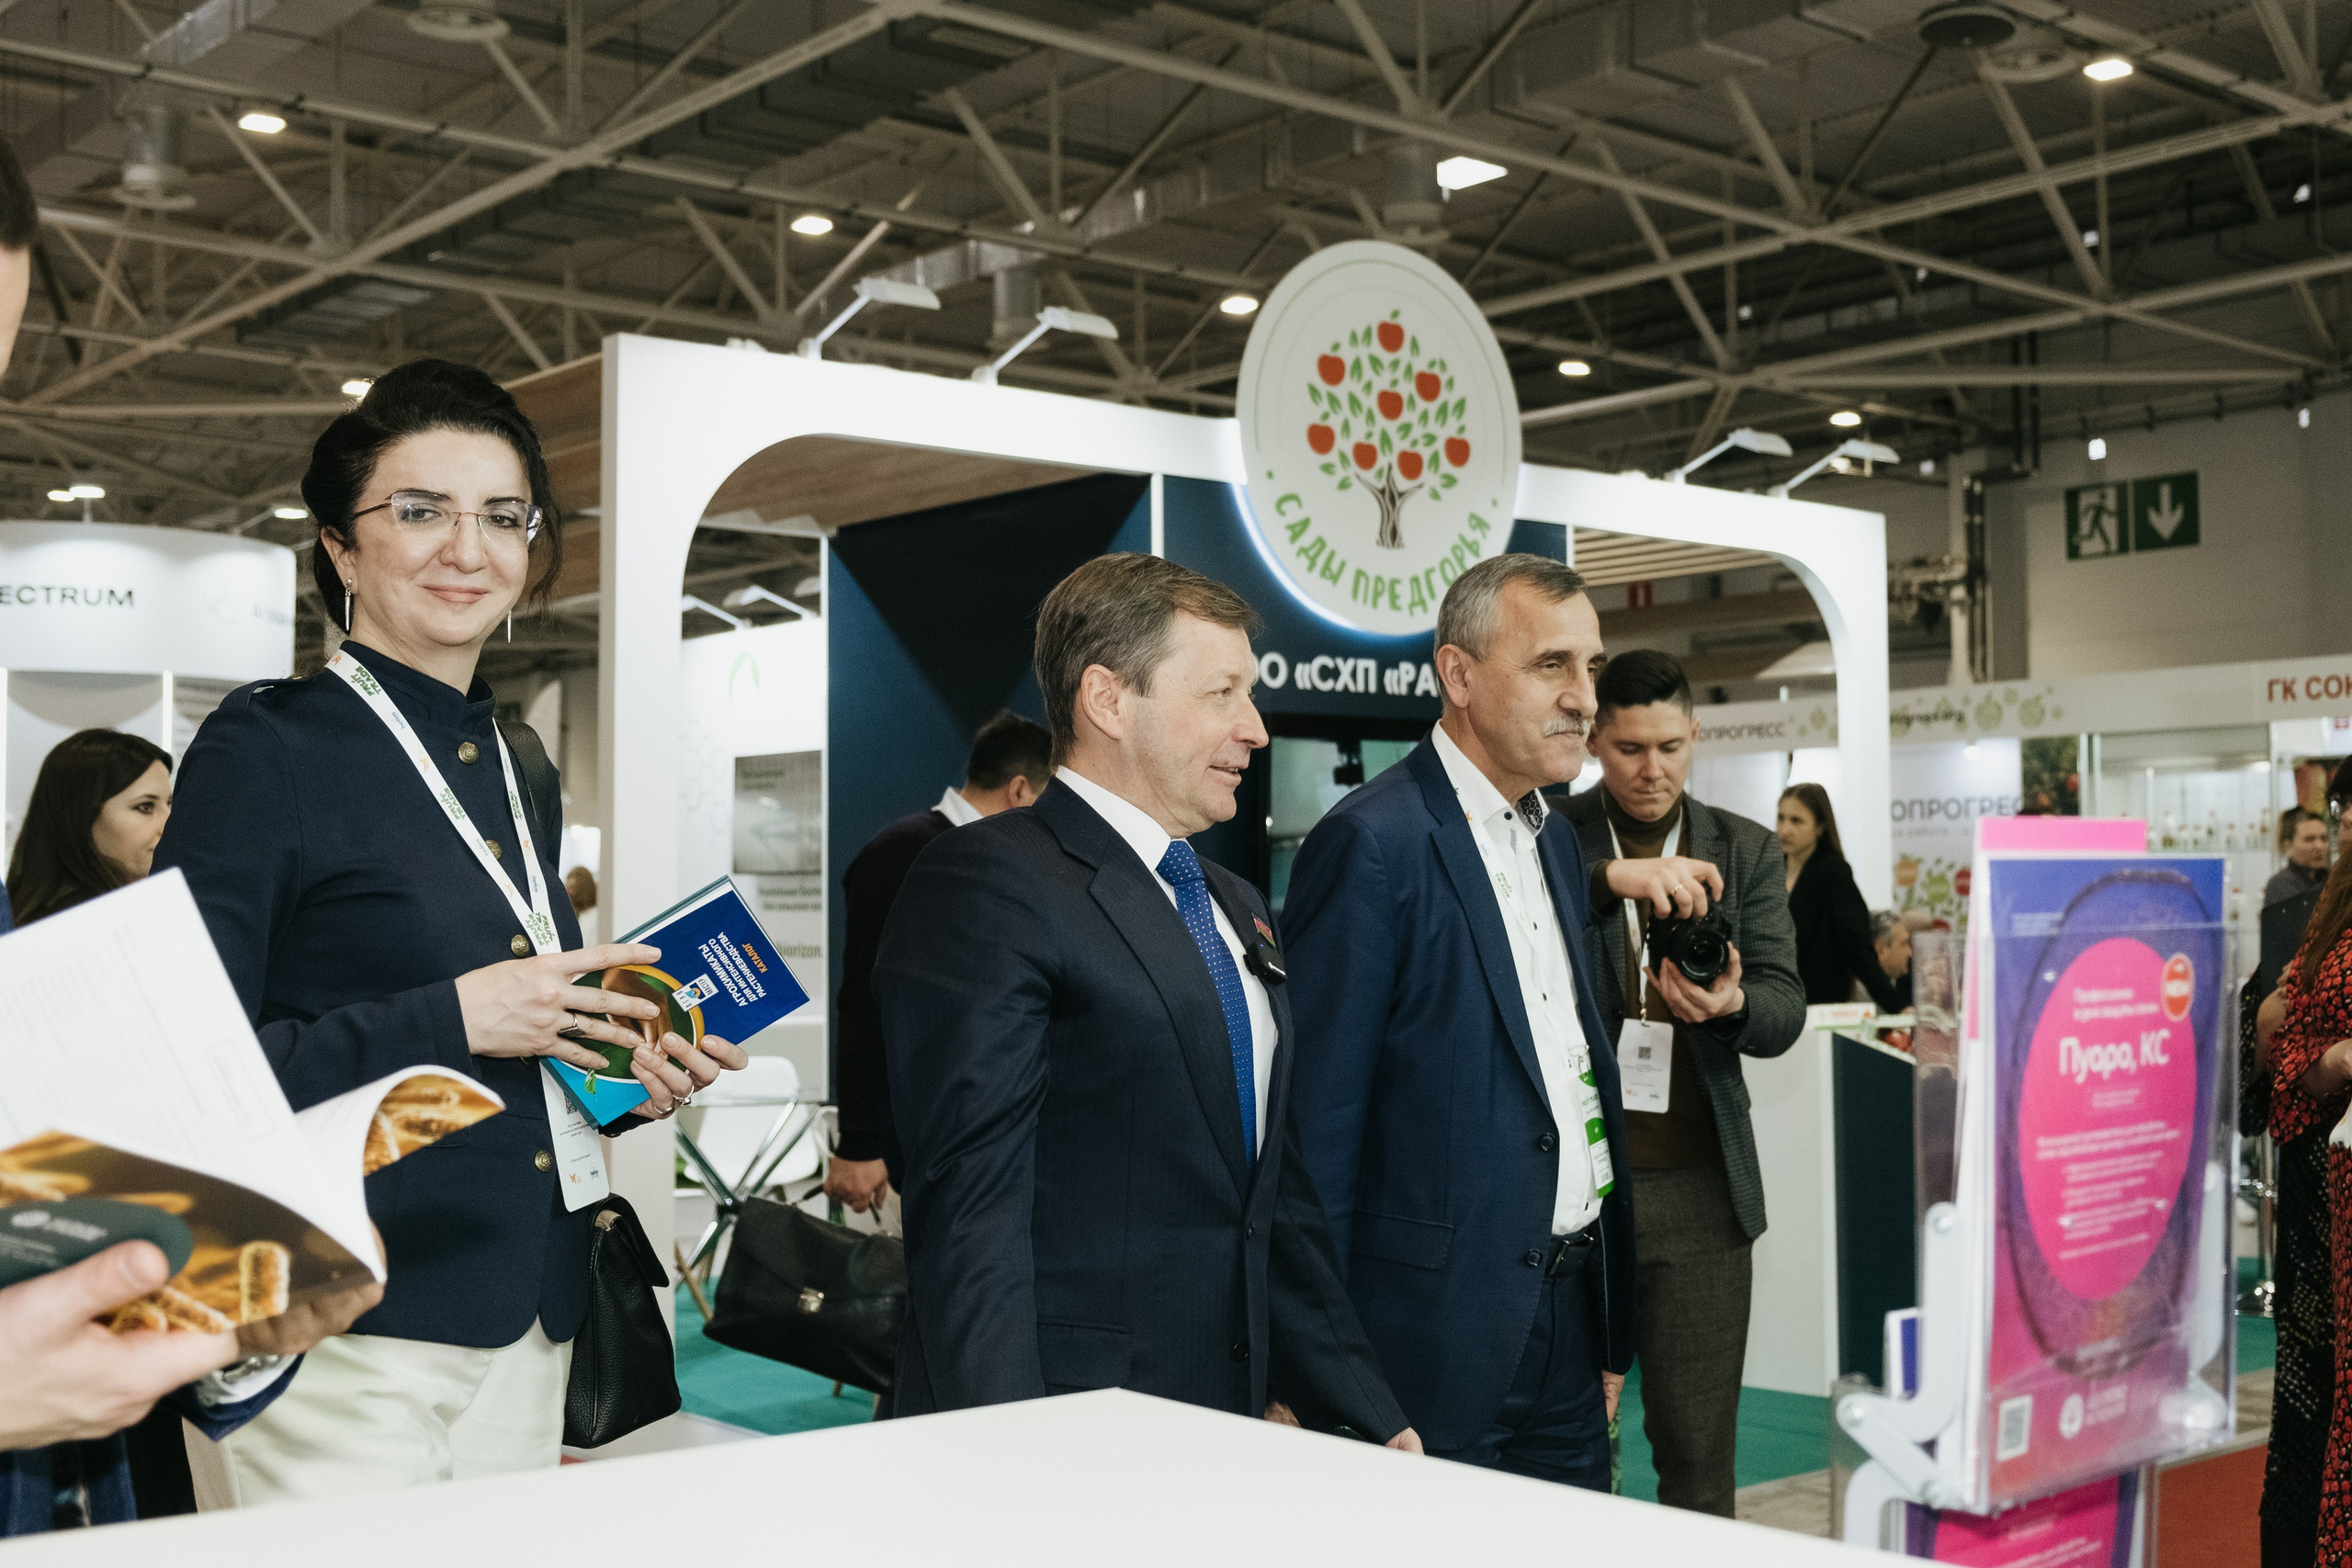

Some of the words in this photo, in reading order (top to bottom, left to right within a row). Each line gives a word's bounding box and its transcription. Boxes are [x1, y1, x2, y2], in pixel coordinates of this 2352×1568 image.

[1274, 492, 1346, 586] САДЫ
[1351, 511, 1490, 616] ПРЕДГОРЬЯ
[351, 673, 376, 696] FRUIT
[355, 665, 382, 695] TRADE
[1253, 651, 1288, 689] О
[1294, 654, 1377, 694] «СХП
[2267, 677, 2297, 703] ГК
[391, 711, 406, 729] helios
[440, 793, 461, 820] FRUIT
[443, 787, 466, 820] TRADE
[707, 938, 748, 989] ИНТЕНСИВНОГО
[717, 931, 767, 998] РАСТЕНИЕВОДСТВА
[741, 942, 768, 974] КАТАЛОГ
[697, 978, 714, 996] МАСТЕР
[698, 943, 749, 1007] АГРОХИМИКАТЫ
[742, 987, 759, 1002] ДЛЯ
[2059, 1036, 2137, 1085] Пуаро,
[2140, 1028, 2171, 1066] КС
